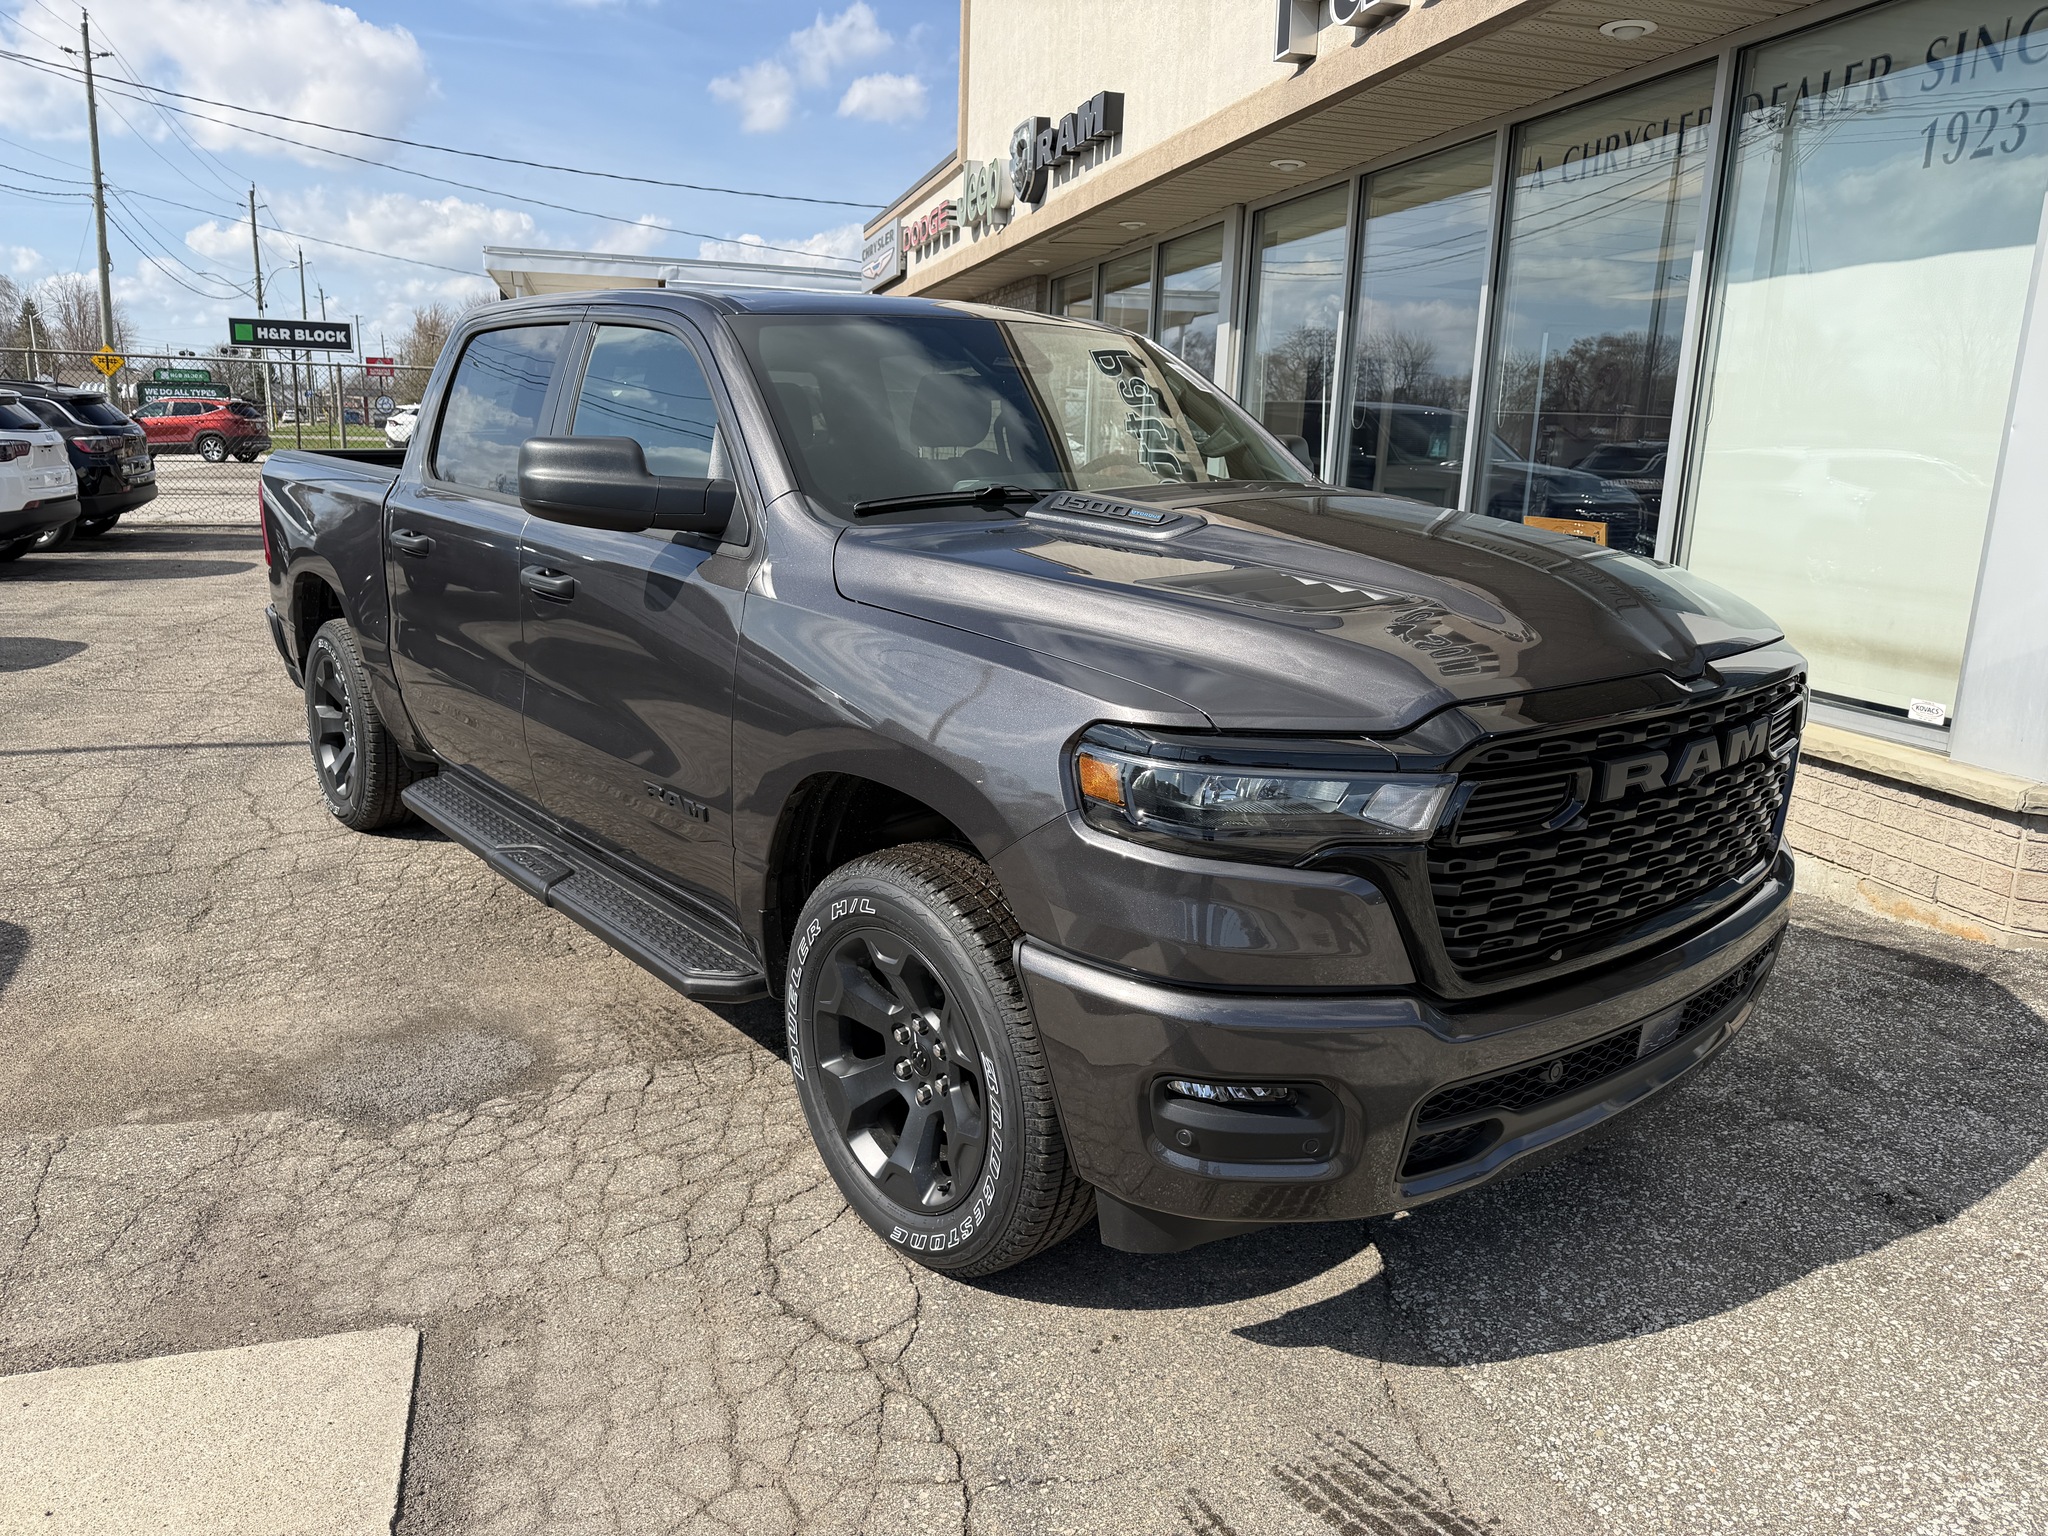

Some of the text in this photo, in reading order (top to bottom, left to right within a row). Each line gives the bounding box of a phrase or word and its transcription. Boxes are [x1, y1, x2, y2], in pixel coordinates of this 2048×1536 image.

[1036, 90, 1108, 170] RAM
[1529, 156, 1545, 194] A
[1561, 106, 1713, 184] CHRYSLER
[1740, 53, 1893, 130] DEALER
[1921, 97, 2030, 169] 1923
[902, 199, 950, 253] DODGE
[957, 157, 1000, 228] Jeep
[861, 229, 895, 262] CHRYSLER
[257, 327, 347, 343] H&R BLOCK
[159, 388, 173, 396] DO
[174, 388, 190, 396] ALL
[190, 389, 217, 397] TYPES
[1058, 495, 1132, 517] 1500
[1915, 704, 1940, 715] KOVACS
[1600, 716, 1769, 802] RAM
[787, 898, 876, 1081] DUELER H/L
[890, 1050, 1003, 1251] BRIDGESTONE
